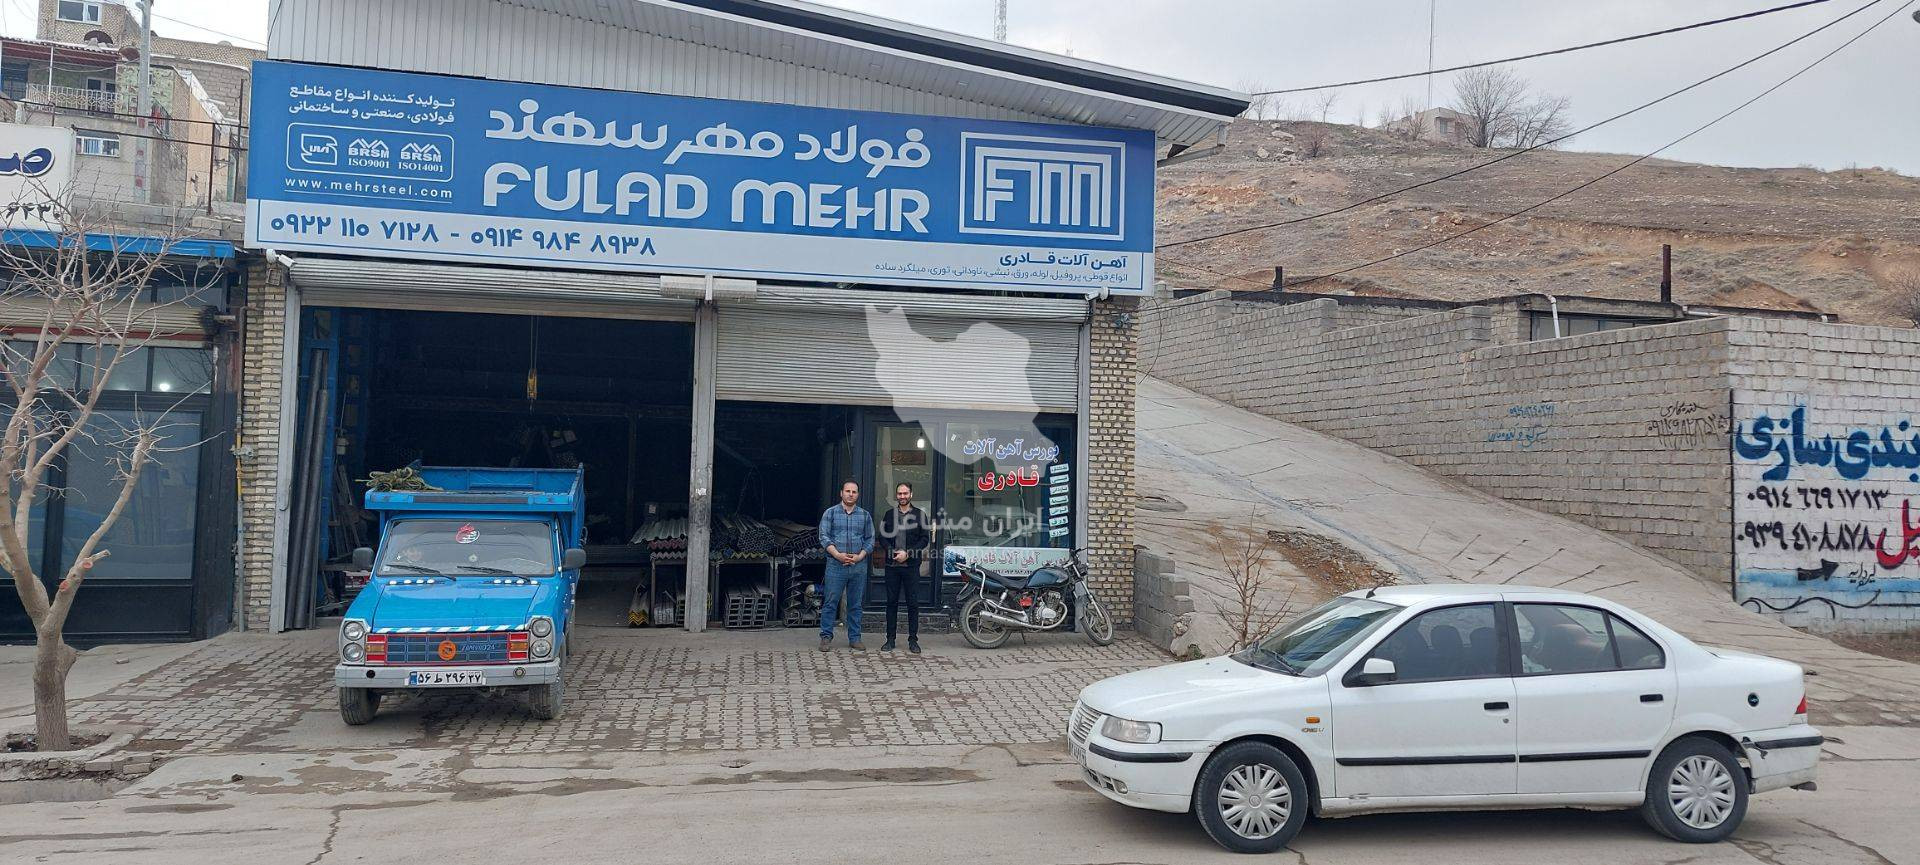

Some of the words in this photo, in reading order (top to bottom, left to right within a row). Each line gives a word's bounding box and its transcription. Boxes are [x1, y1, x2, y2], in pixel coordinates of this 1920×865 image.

[289, 85, 332, 98] مقاطع
[334, 88, 370, 101] انواع
[289, 101, 349, 114] ساختمانی
[351, 108, 359, 118] و
[361, 108, 404, 119] صنعتی
[485, 98, 668, 151] سهند
[662, 122, 784, 166] مهر
[794, 124, 930, 178] فولاد
[348, 147, 390, 158] BRSM
[400, 151, 442, 163] BRSM
[348, 158, 390, 169] ISO9001
[398, 162, 444, 173] ISO14001
[284, 177, 453, 198] www.mehrsteel.com
[483, 162, 708, 219] FULAD
[731, 179, 930, 233] MEHR
[999, 251, 1056, 267] قادری
[1058, 253, 1089, 266] آلات
[1091, 255, 1128, 270] آهن
[875, 262, 896, 272] ساده
[1109, 273, 1128, 284] انواع
[963, 437, 997, 455] آلات
[996, 438, 1024, 460] آهن
[1735, 407, 1833, 482] سازی
[1023, 444, 1060, 463] بورس
[977, 464, 1040, 491] قادری
